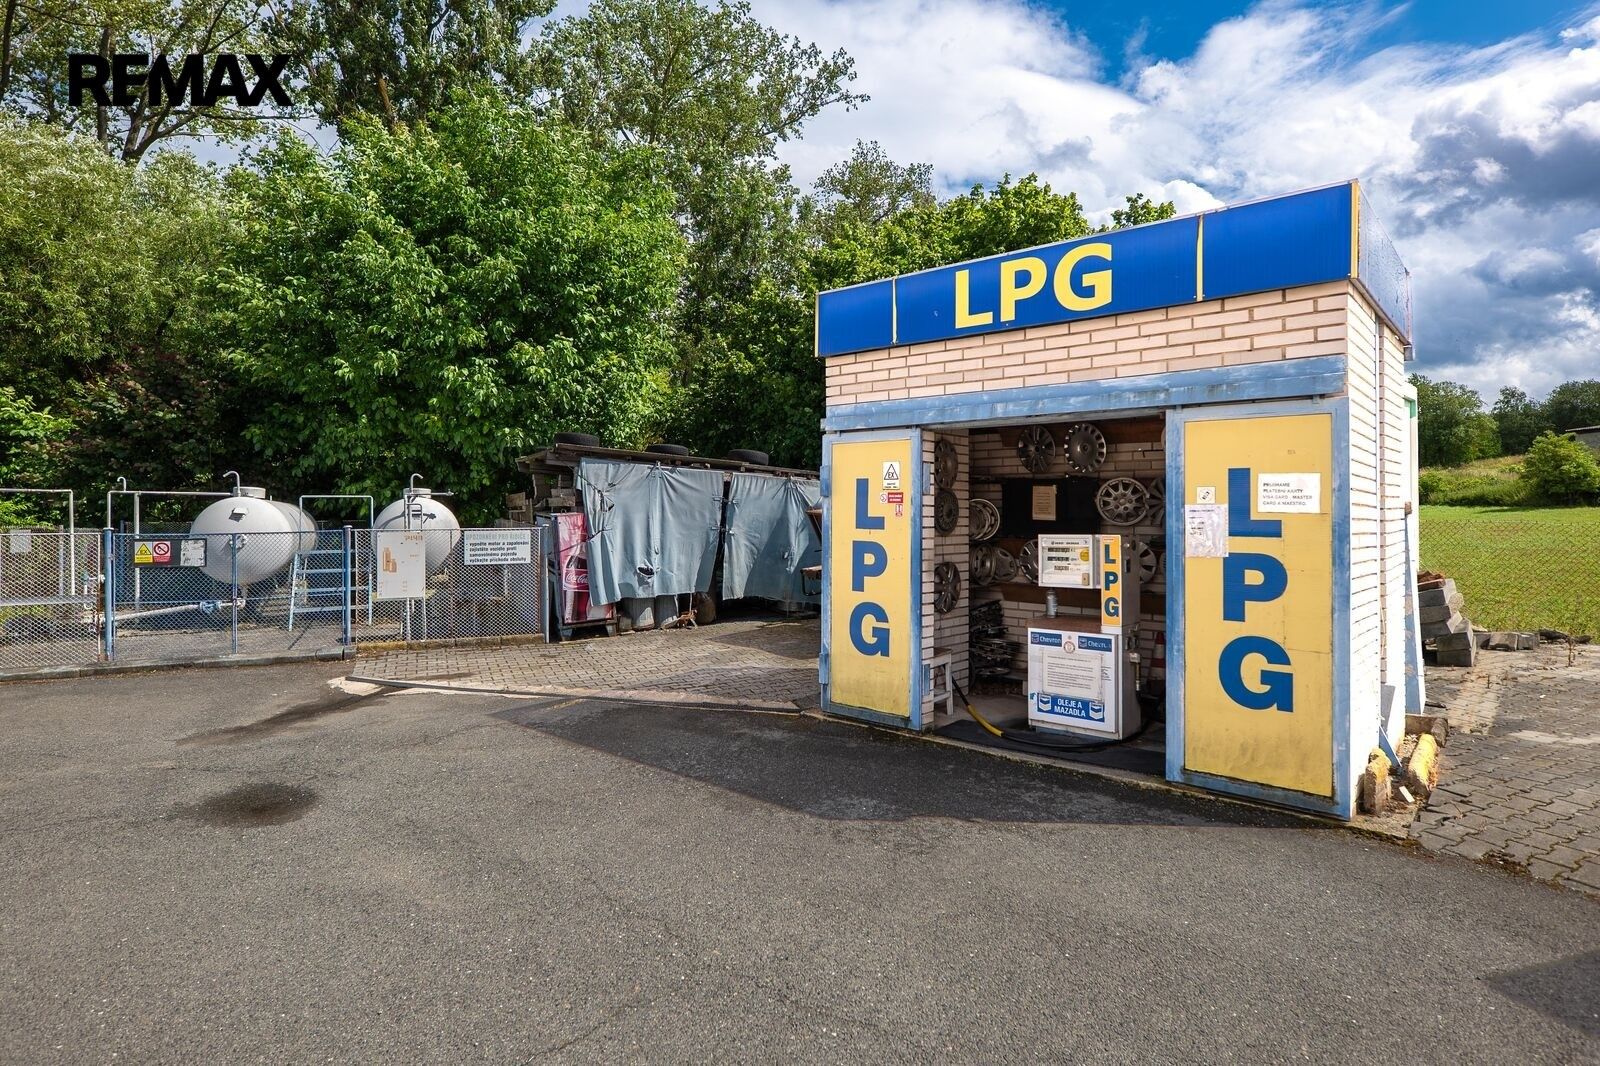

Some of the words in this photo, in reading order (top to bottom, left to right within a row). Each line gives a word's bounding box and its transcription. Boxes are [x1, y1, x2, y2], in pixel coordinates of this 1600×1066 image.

[955, 242, 1112, 329] LPG
[849, 478, 890, 657] LPG
[1104, 544, 1119, 617] LPG
[1218, 467, 1294, 713] LPG
[1040, 635, 1061, 644] Chevron
[1054, 705, 1086, 717] MAZADLA
[1057, 698, 1077, 708] OLEJE
[1077, 701, 1083, 709] A
